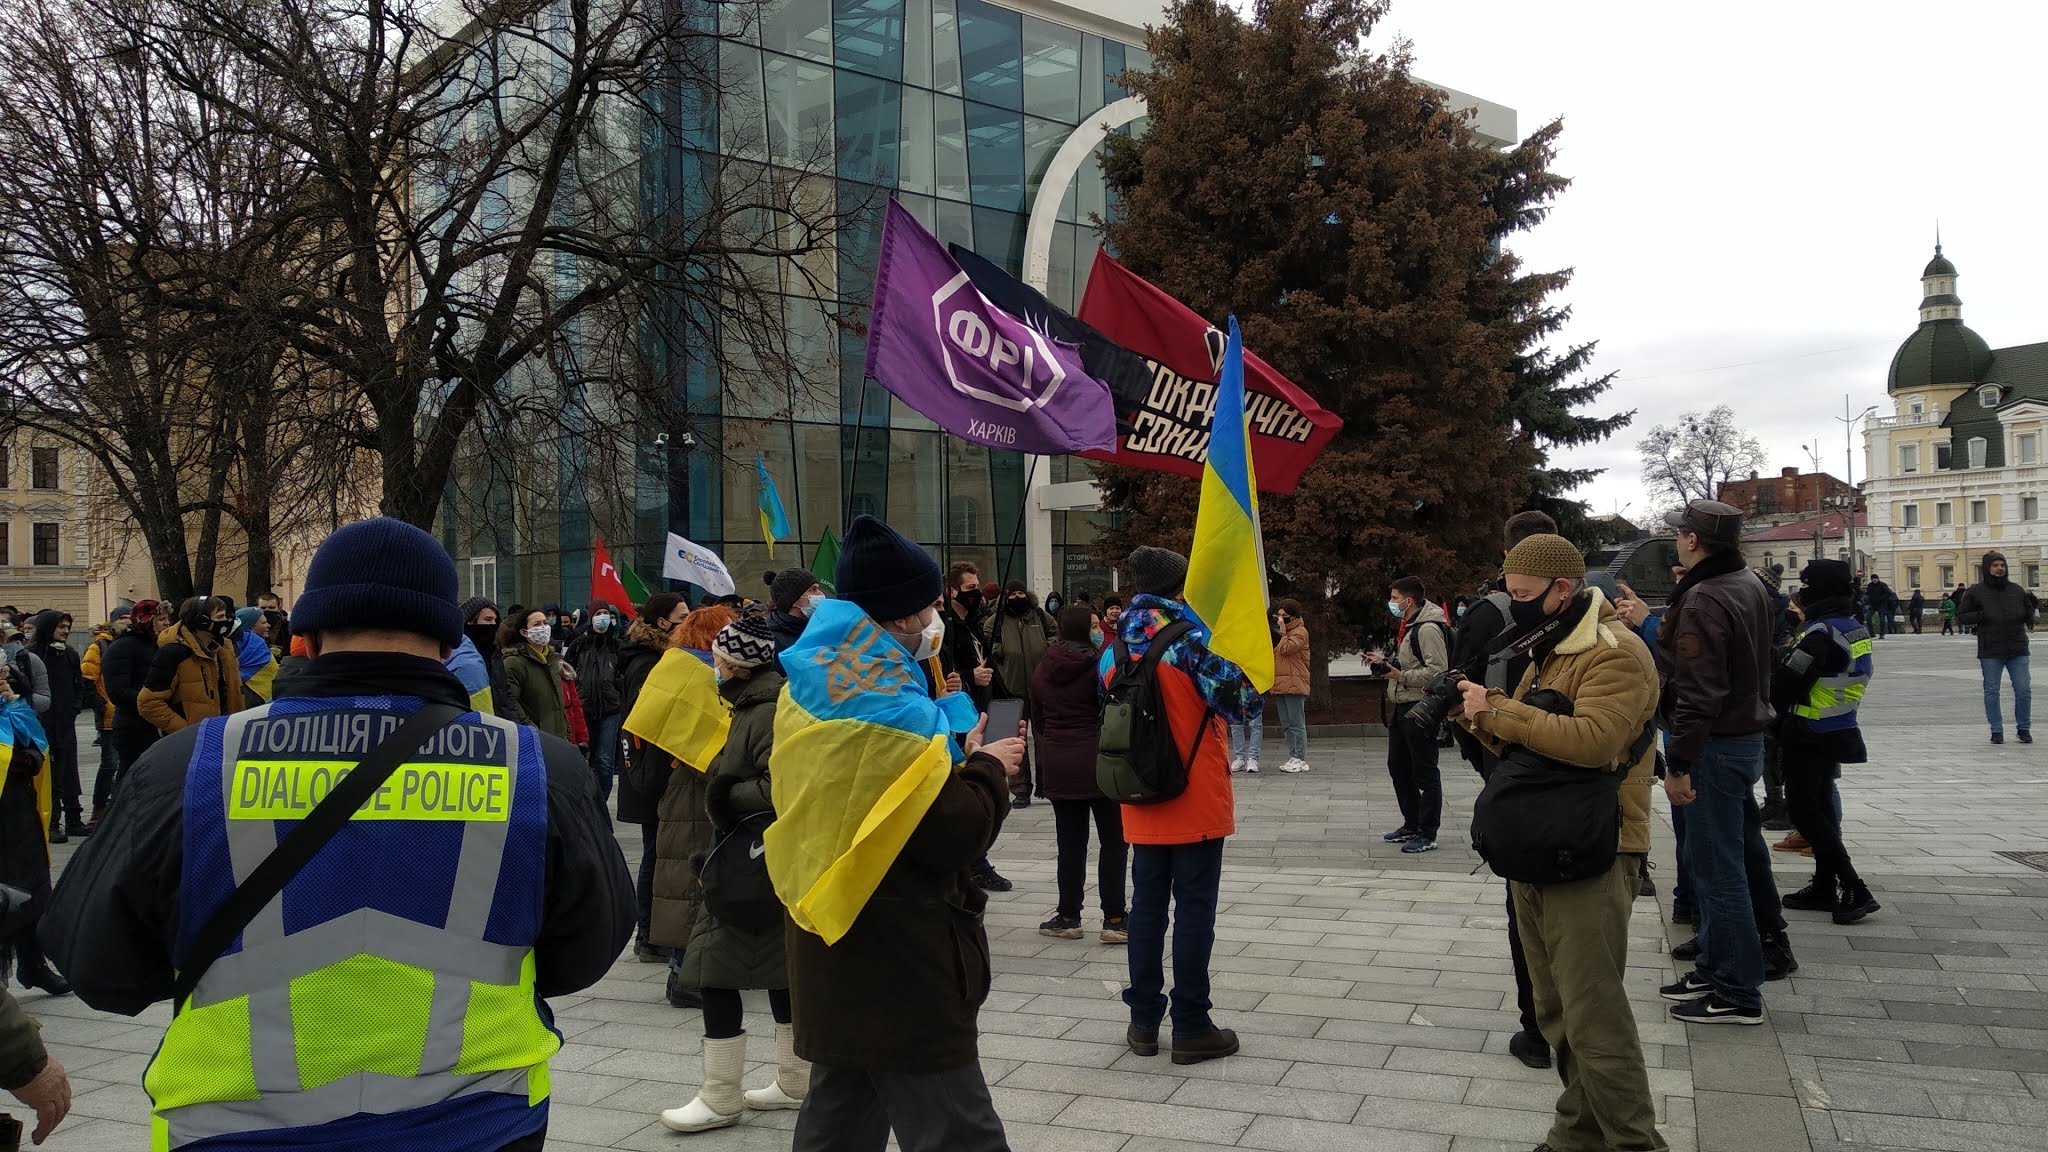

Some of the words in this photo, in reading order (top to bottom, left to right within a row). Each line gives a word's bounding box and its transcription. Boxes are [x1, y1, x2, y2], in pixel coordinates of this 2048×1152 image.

[949, 310, 1034, 389] ФРІ
[967, 418, 1017, 445] ХАРКІВ
[1126, 410, 1210, 463] СОКИ
[1517, 630, 1545, 649] DIGITAL
[1544, 620, 1560, 633] EOS
[245, 714, 371, 755] ПОЛІЦІЯ
[240, 767, 392, 811] DIALOE
[401, 770, 503, 813] POLICE
